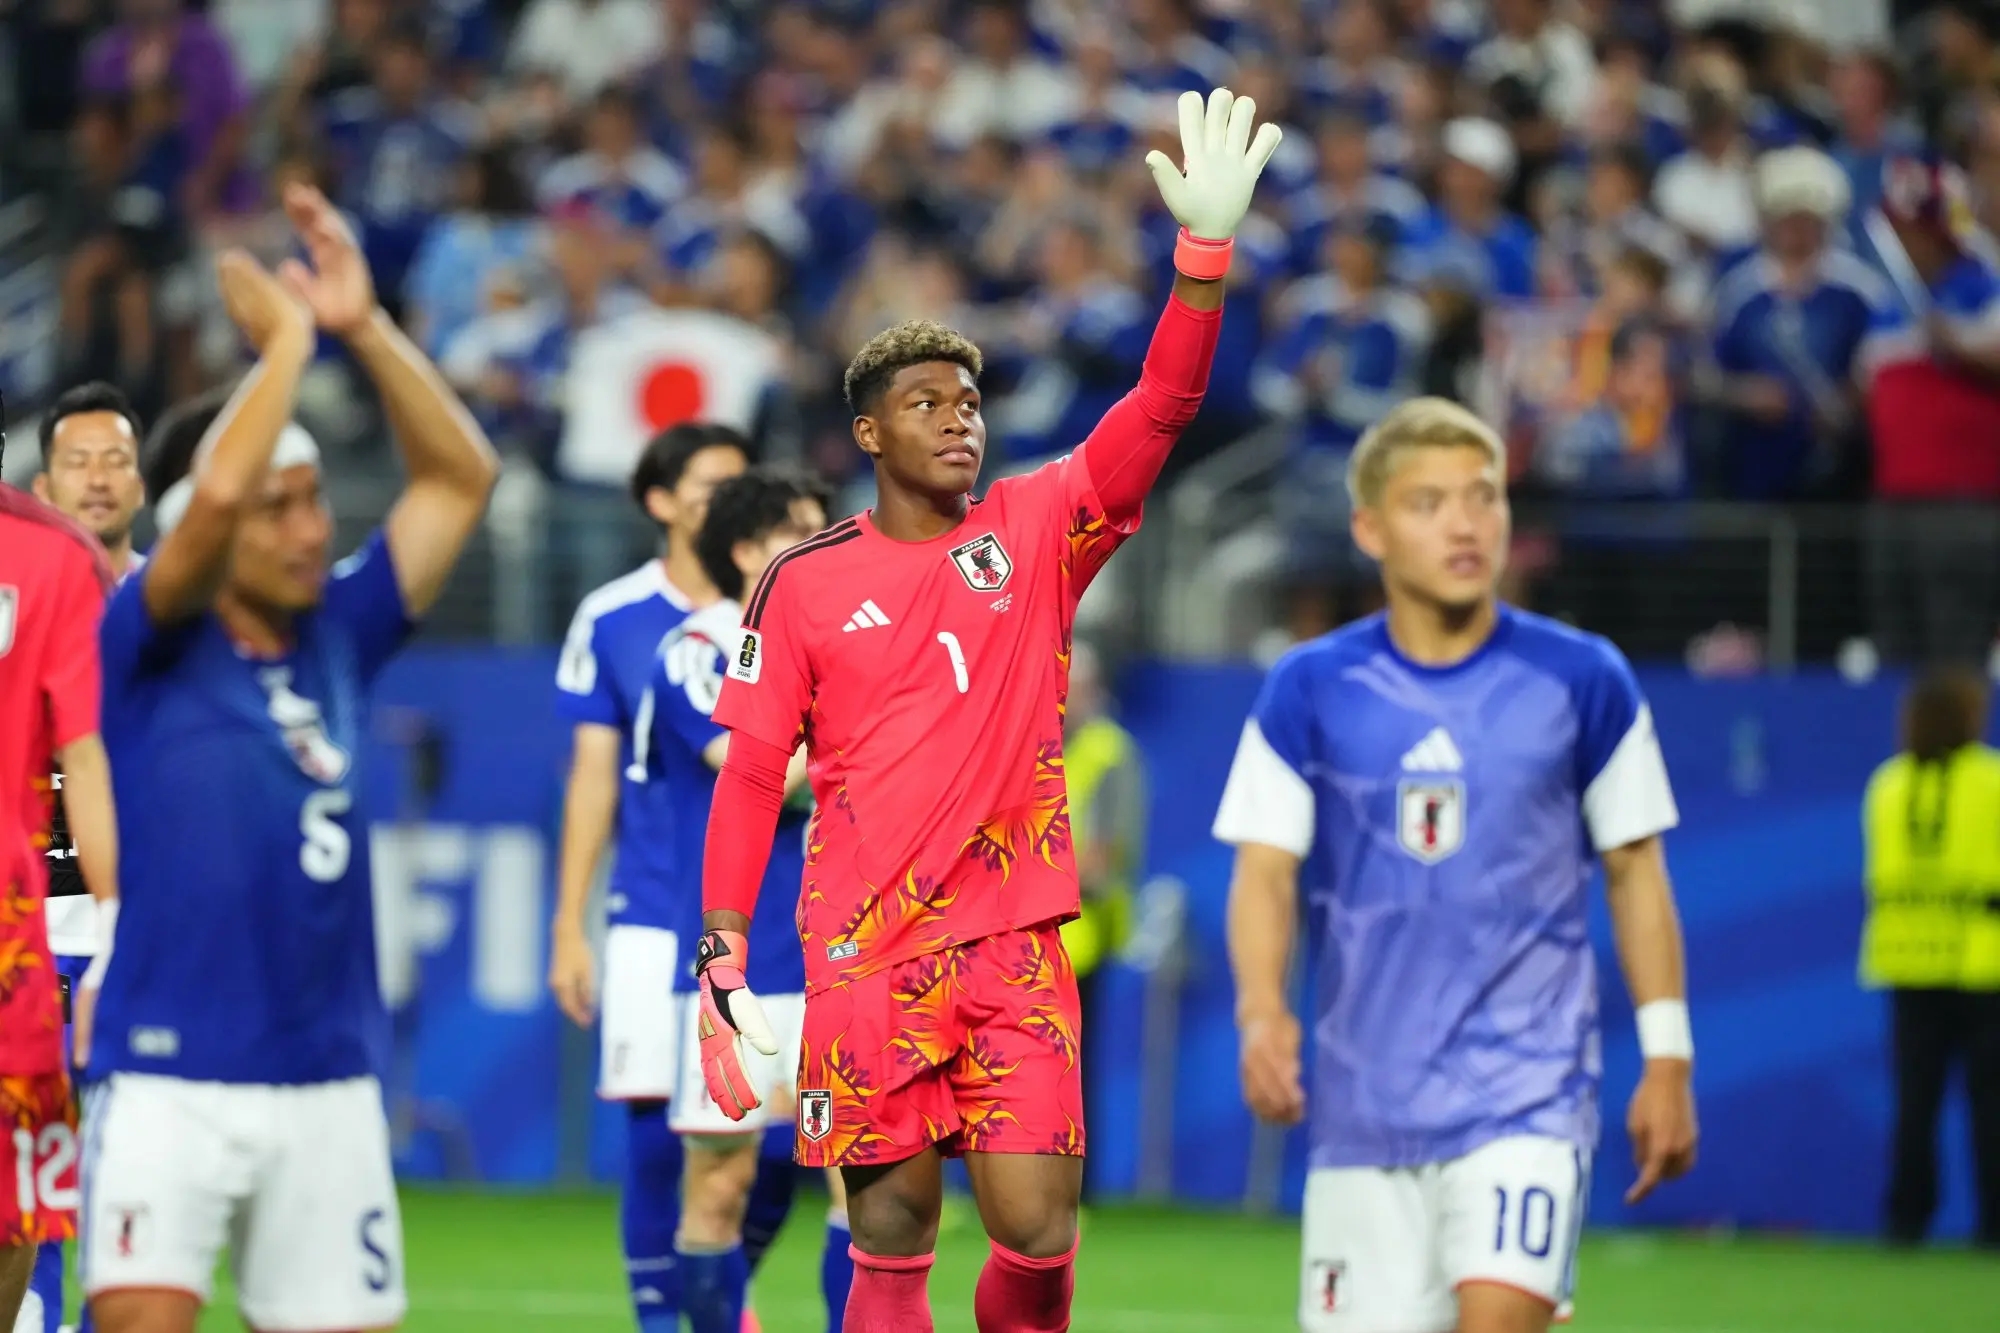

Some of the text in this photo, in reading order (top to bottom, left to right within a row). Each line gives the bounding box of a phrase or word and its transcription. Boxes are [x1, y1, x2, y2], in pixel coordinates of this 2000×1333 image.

[961, 539, 984, 553] JAPAN
[982, 572, 1002, 585] JFA
[937, 631, 969, 694] 1
[12, 1122, 82, 1213] 12
[1494, 1185, 1555, 1258] 10
